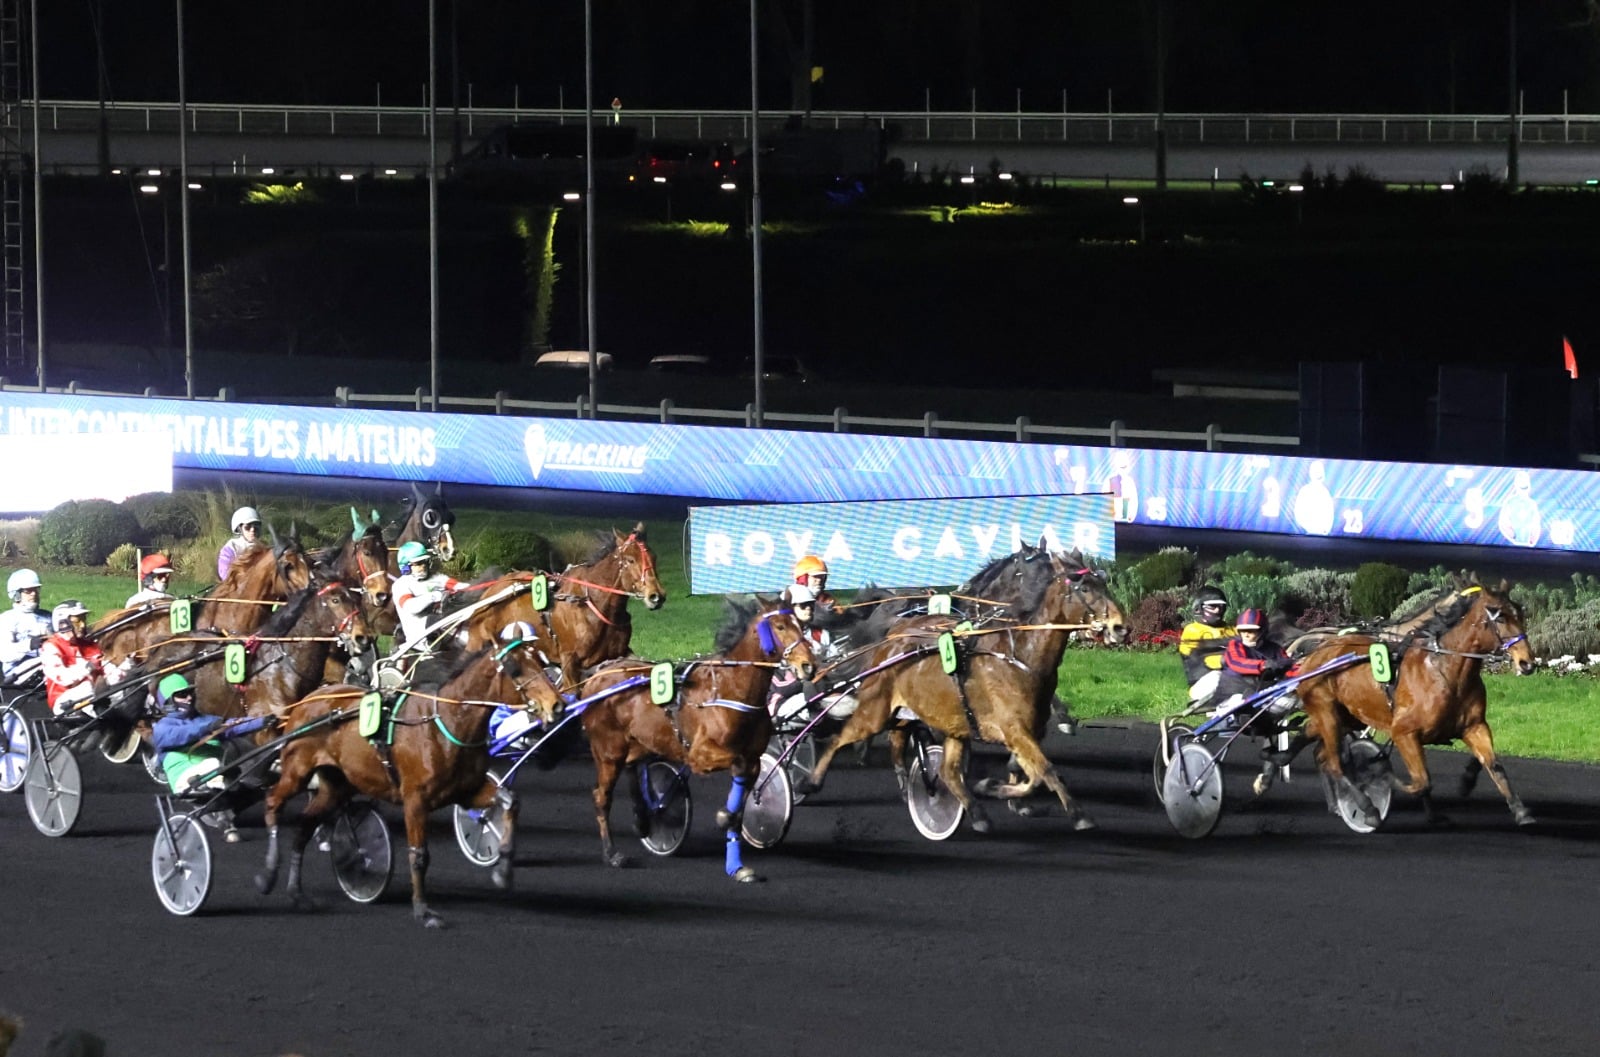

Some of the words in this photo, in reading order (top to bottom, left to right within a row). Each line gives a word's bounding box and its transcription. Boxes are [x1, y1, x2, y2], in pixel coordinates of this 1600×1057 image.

[254, 419, 299, 459] DES
[305, 421, 436, 467] AMATEURS
[893, 522, 1100, 560] CAVIAR
[535, 582, 543, 603] 9
[173, 607, 189, 628] 13
[946, 641, 953, 665] 4
[1375, 651, 1385, 675] 3
[229, 655, 240, 676] 6
[656, 670, 668, 695] 5
[366, 700, 377, 728] 7
